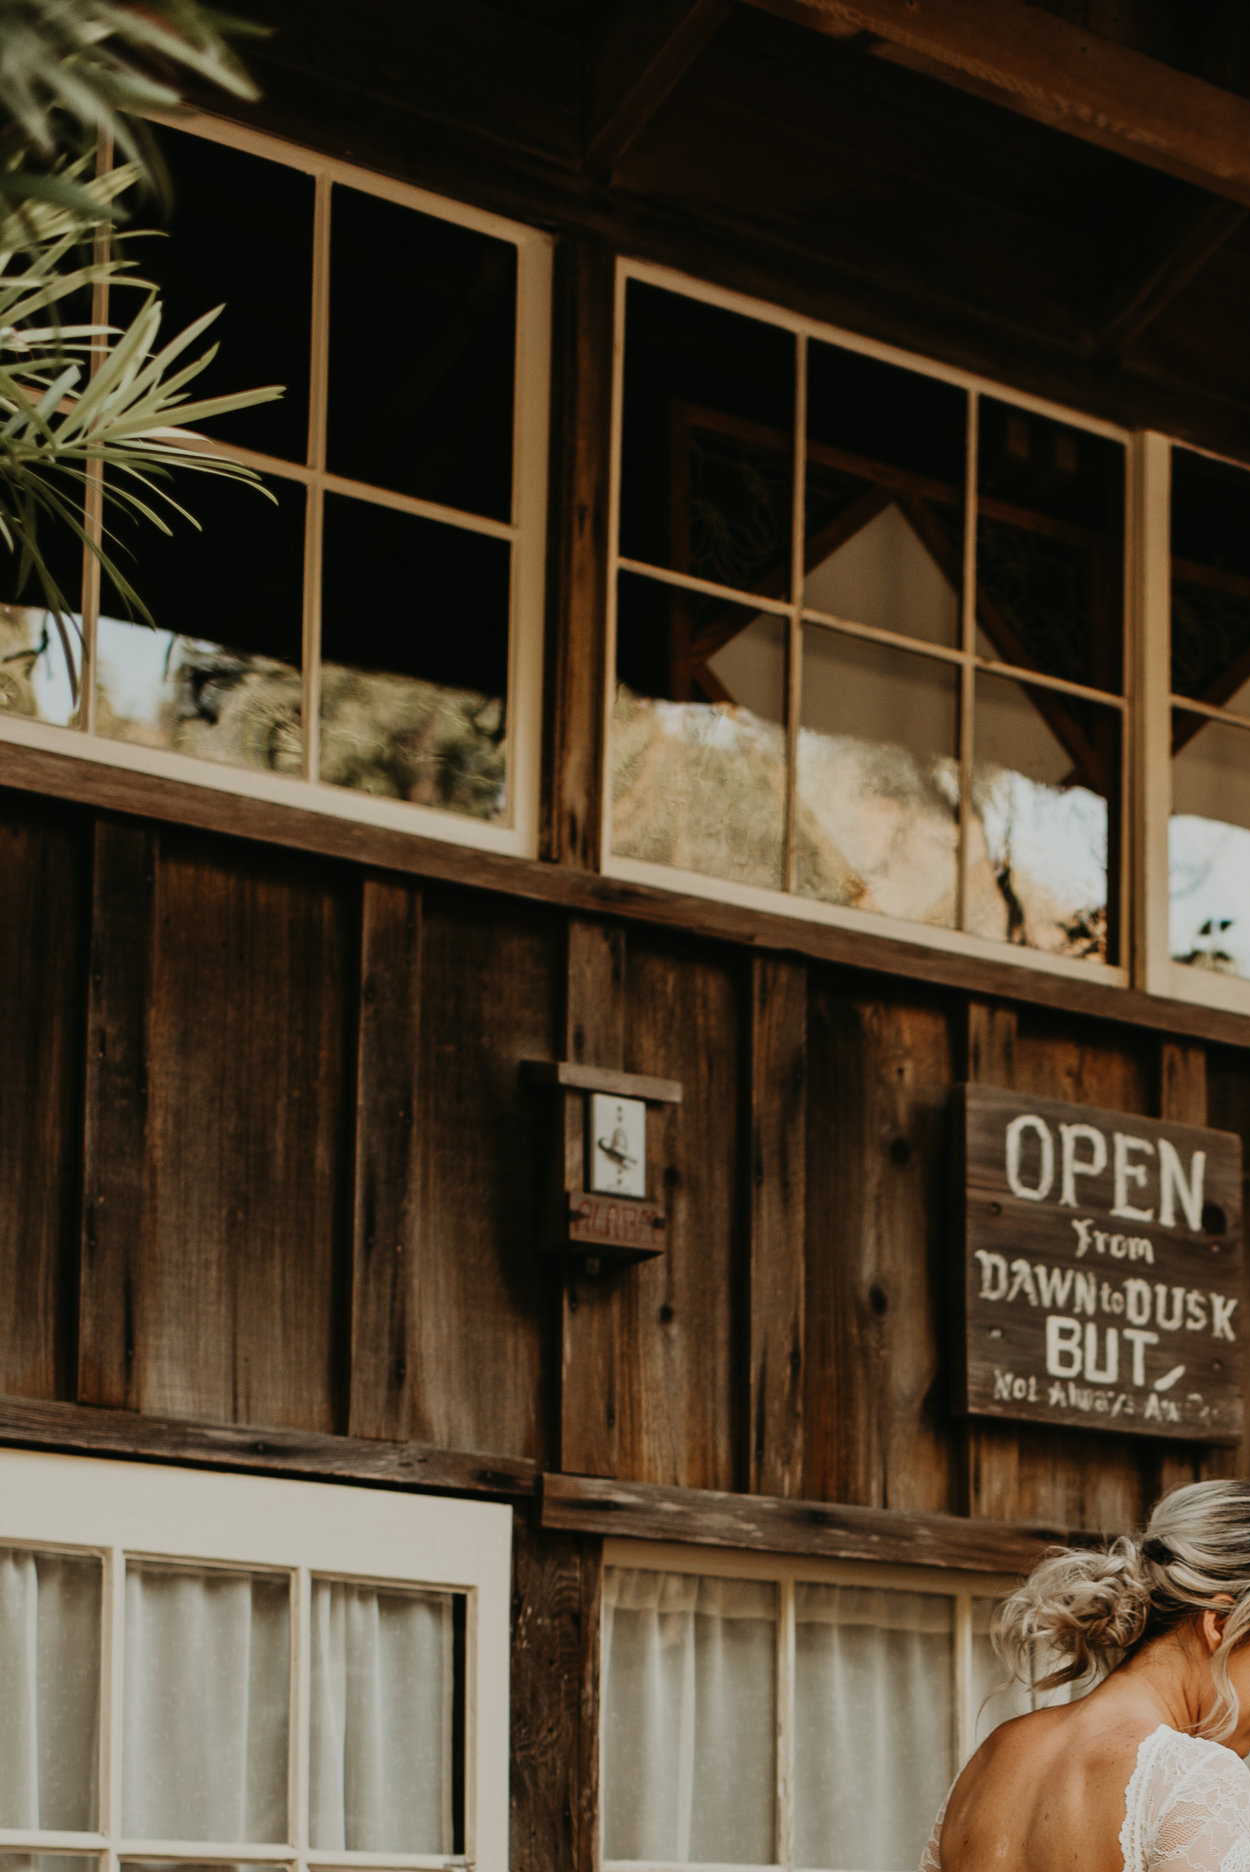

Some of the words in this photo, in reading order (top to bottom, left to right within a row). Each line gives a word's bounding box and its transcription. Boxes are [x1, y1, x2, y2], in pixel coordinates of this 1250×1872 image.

[1006, 1114, 1206, 1232] OPEN
[974, 1250, 1097, 1315] DAWN
[1100, 1282, 1125, 1314] to
[1123, 1278, 1238, 1342] DUSK
